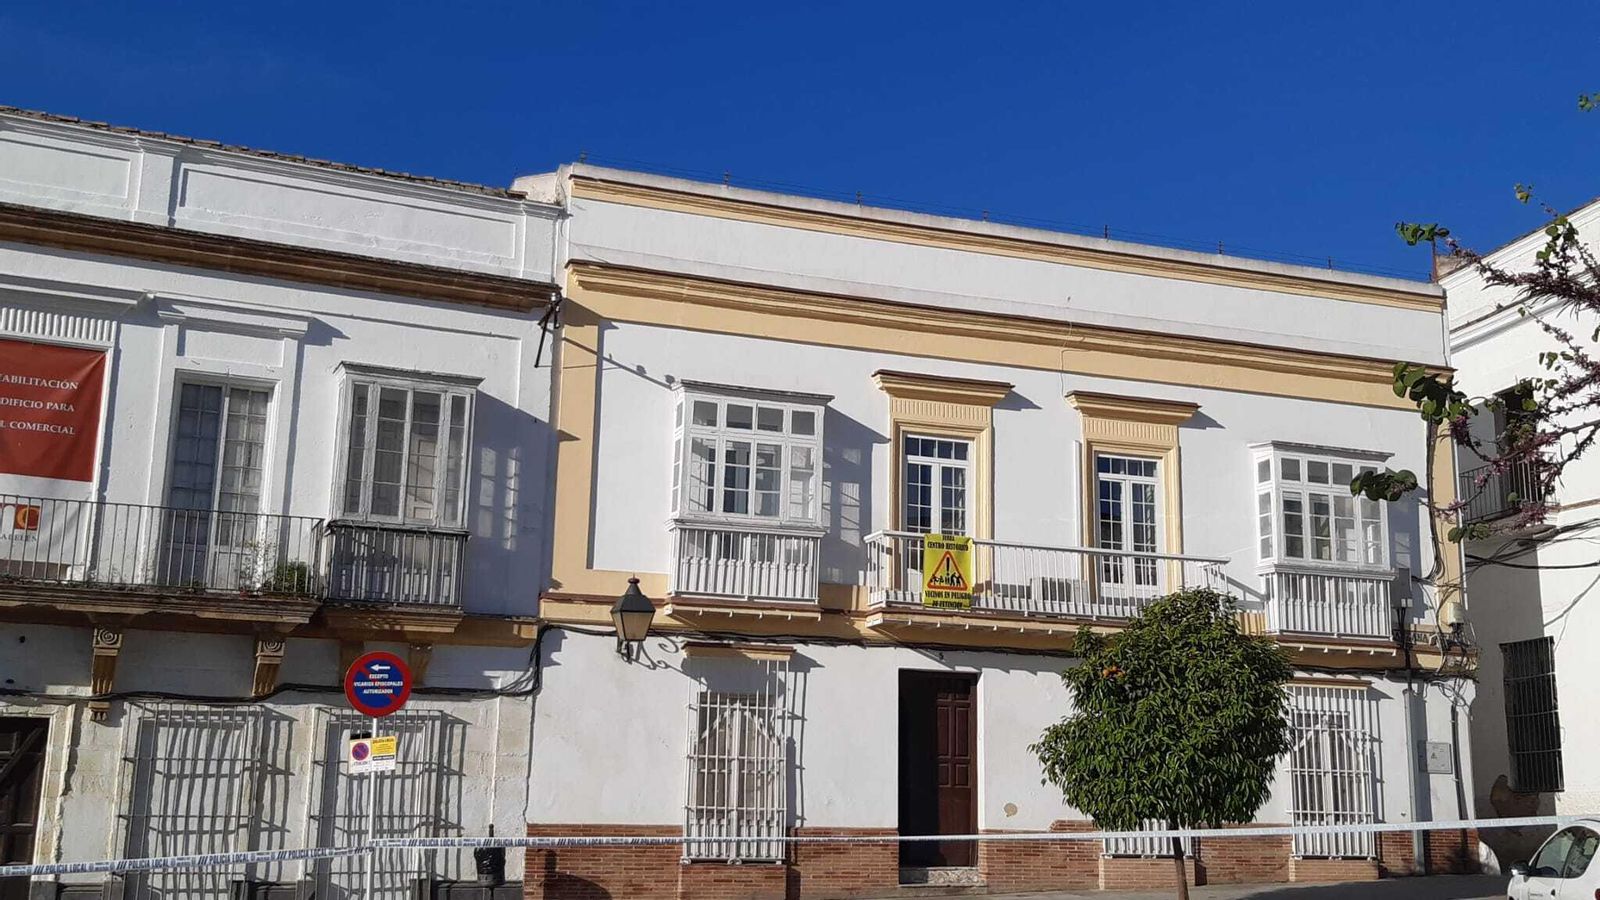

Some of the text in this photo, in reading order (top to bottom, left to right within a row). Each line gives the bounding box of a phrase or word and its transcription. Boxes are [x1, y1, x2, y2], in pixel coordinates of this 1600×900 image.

[0, 397, 75, 412] DIFICIO PARA
[10, 421, 75, 435] COMERCIAL
[925, 590, 943, 598] VECINOS
[440, 838, 456, 847] LOCAL
[209, 854, 231, 865] POLICIA
[232, 852, 249, 862] LOCAL
[288, 850, 310, 860] POLICIA
[311, 848, 327, 858] LOCAL
[45, 863, 68, 874] POLICIA
[69, 862, 88, 873] LOCAL
[128, 859, 150, 869] POLICIA
[151, 857, 169, 868] LOCAL
